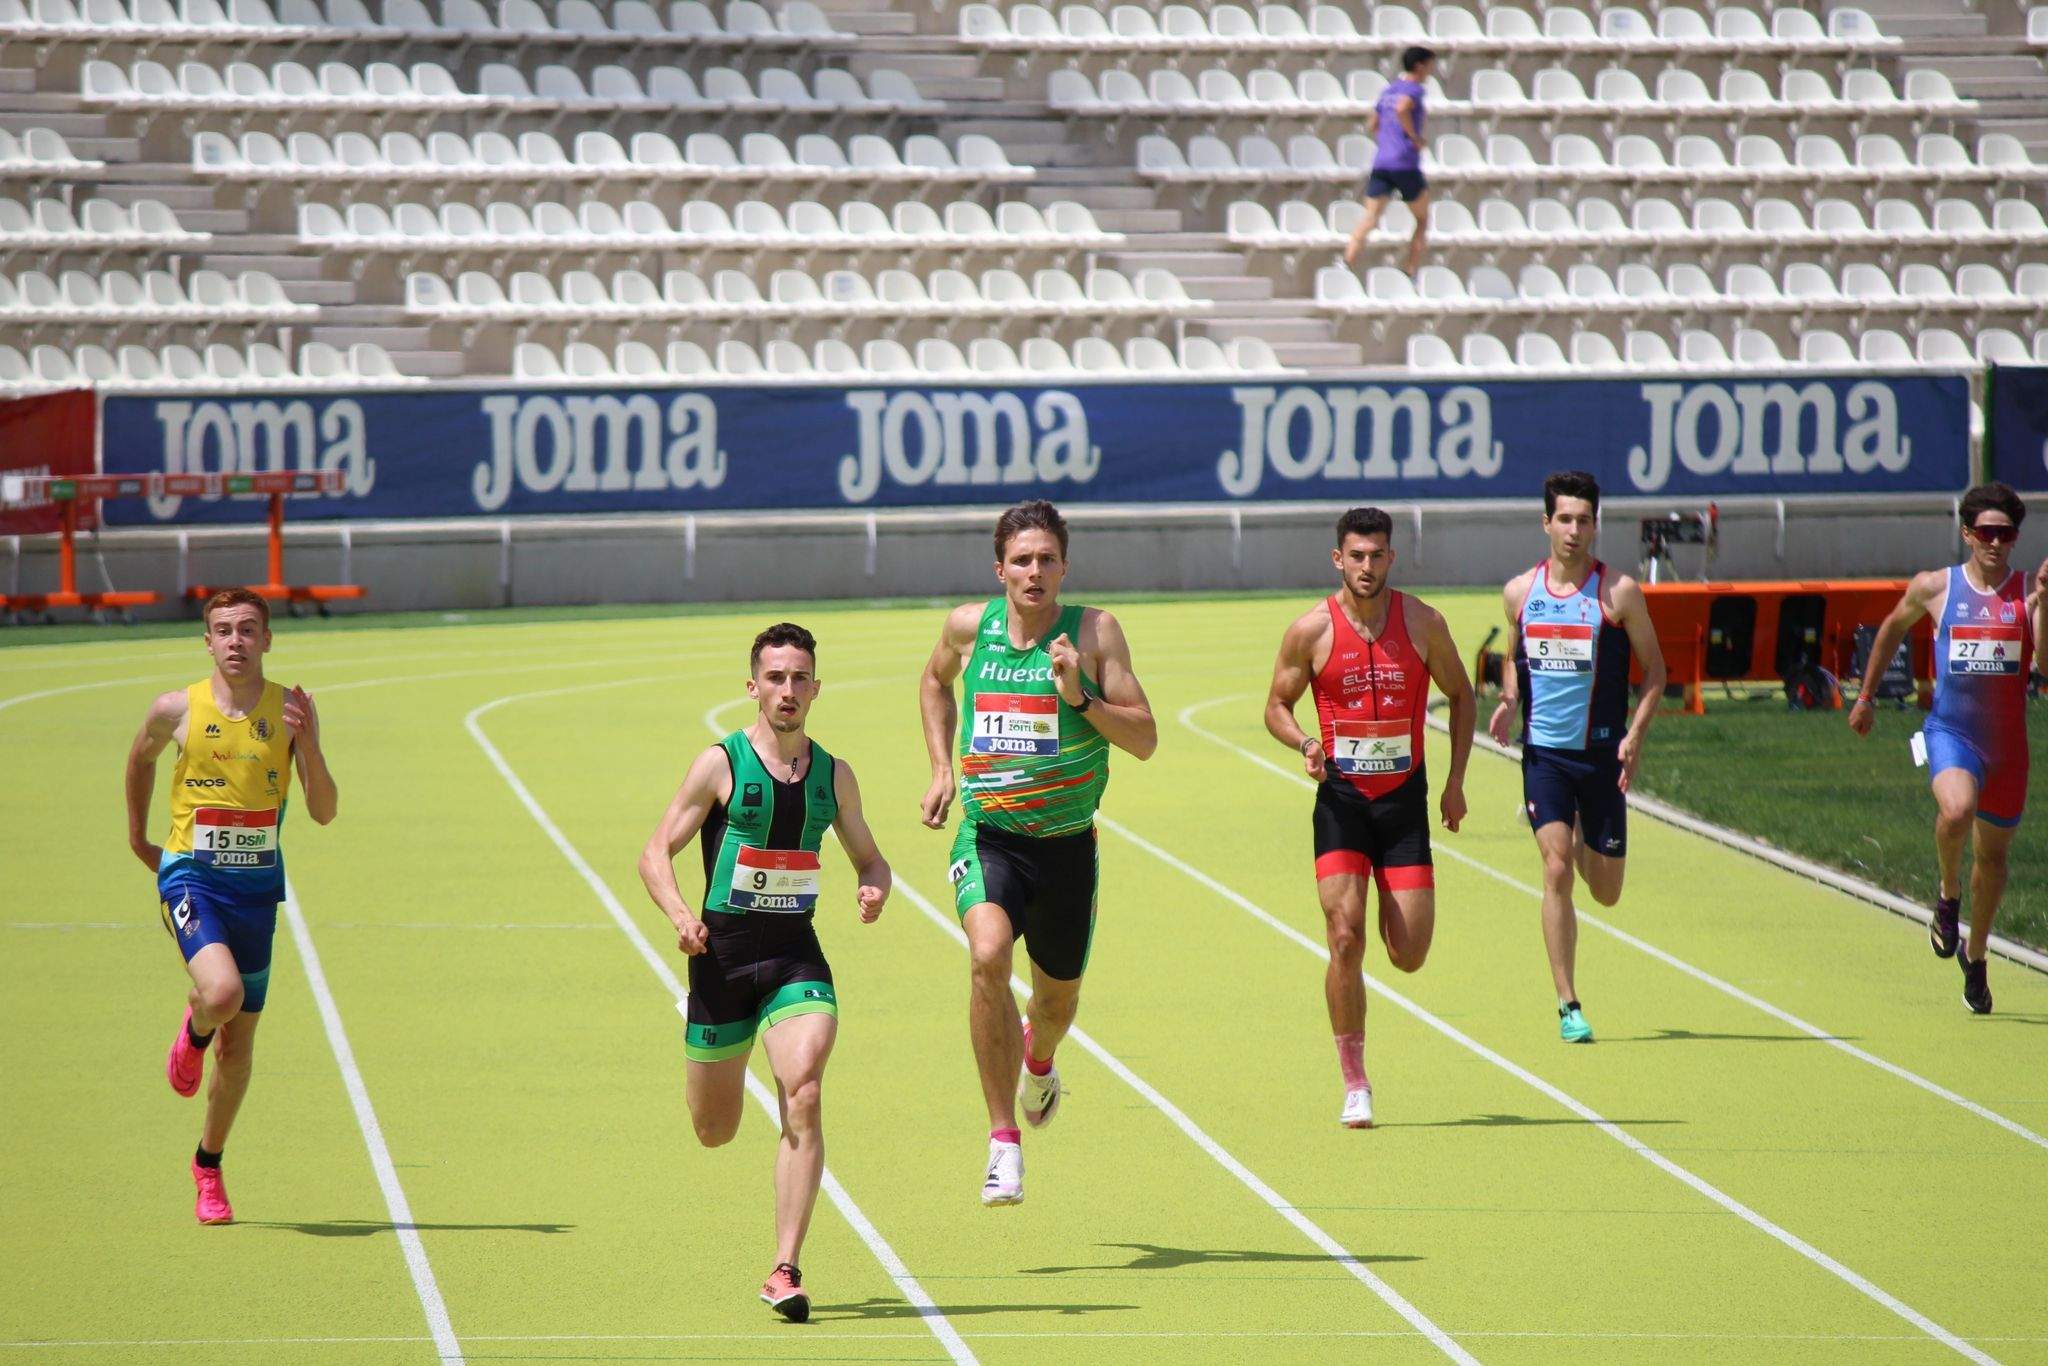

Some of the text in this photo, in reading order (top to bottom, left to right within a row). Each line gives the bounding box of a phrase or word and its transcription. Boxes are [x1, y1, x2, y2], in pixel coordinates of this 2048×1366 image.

[1217, 386, 1504, 496] Joma
[1627, 382, 1911, 492] Joma
[473, 393, 727, 510] Joma
[838, 390, 1101, 502] Joma
[147, 399, 375, 519] Joma
[1539, 641, 1549, 656] 5
[1958, 642, 1979, 658] 27
[1539, 658, 1577, 671] Joma
[1965, 660, 2004, 672] Joma
[1343, 670, 1405, 687] ELCHE
[983, 714, 1004, 734] 11
[988, 738, 1037, 753] Joma
[1350, 739, 1360, 755] 7
[1352, 758, 1396, 771] Joma
[185, 778, 226, 788] EVOS
[205, 830, 231, 850] 15
[235, 832, 266, 846] DSM
[211, 851, 260, 866] Joma
[752, 870, 768, 891] 9
[750, 894, 800, 909] Joma
